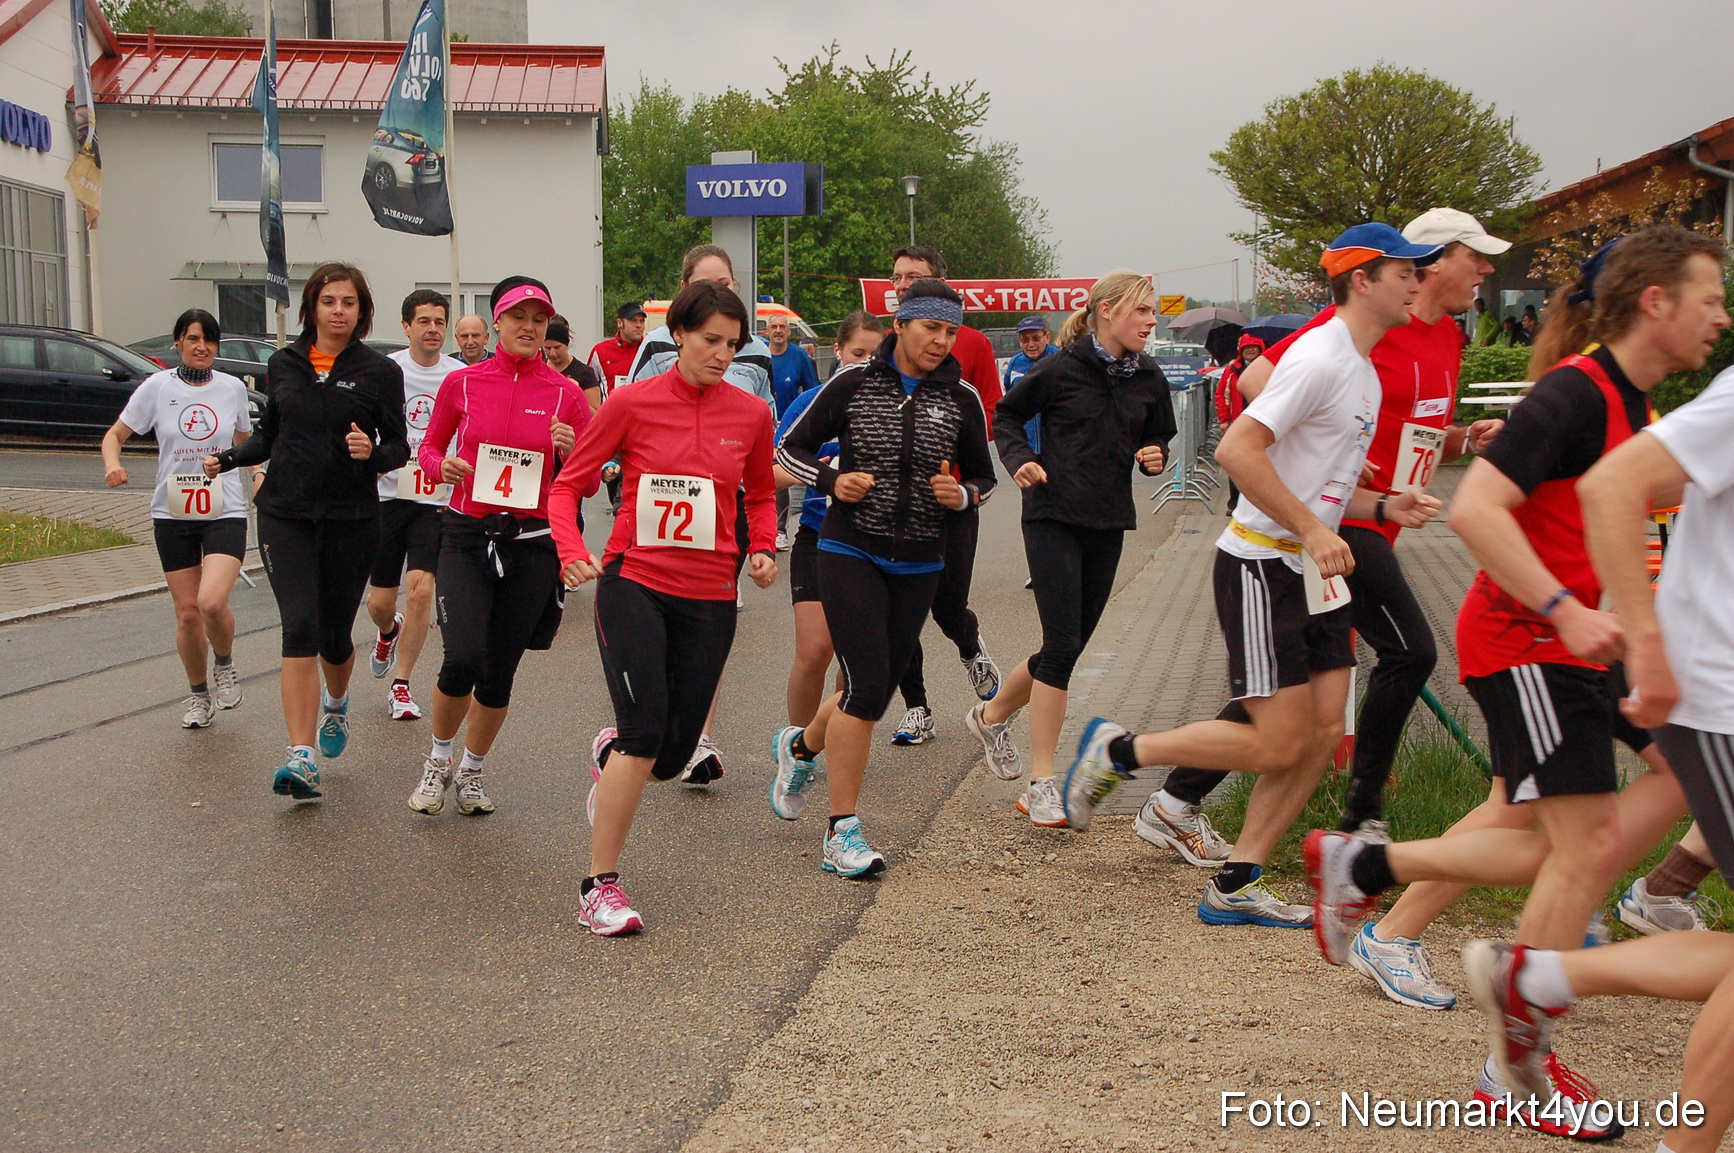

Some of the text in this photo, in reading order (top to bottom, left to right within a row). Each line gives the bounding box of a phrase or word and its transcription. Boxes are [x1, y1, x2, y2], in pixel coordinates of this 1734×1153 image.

[697, 179, 787, 199] VOLVO
[489, 454, 519, 465] WERBUNG
[490, 447, 519, 459] MEYER
[1408, 446, 1434, 487] 78
[494, 465, 513, 498] 4
[650, 479, 685, 488] MEYER
[650, 487, 686, 496] WERBUNG
[181, 488, 211, 515] 70
[654, 500, 693, 542] 72
